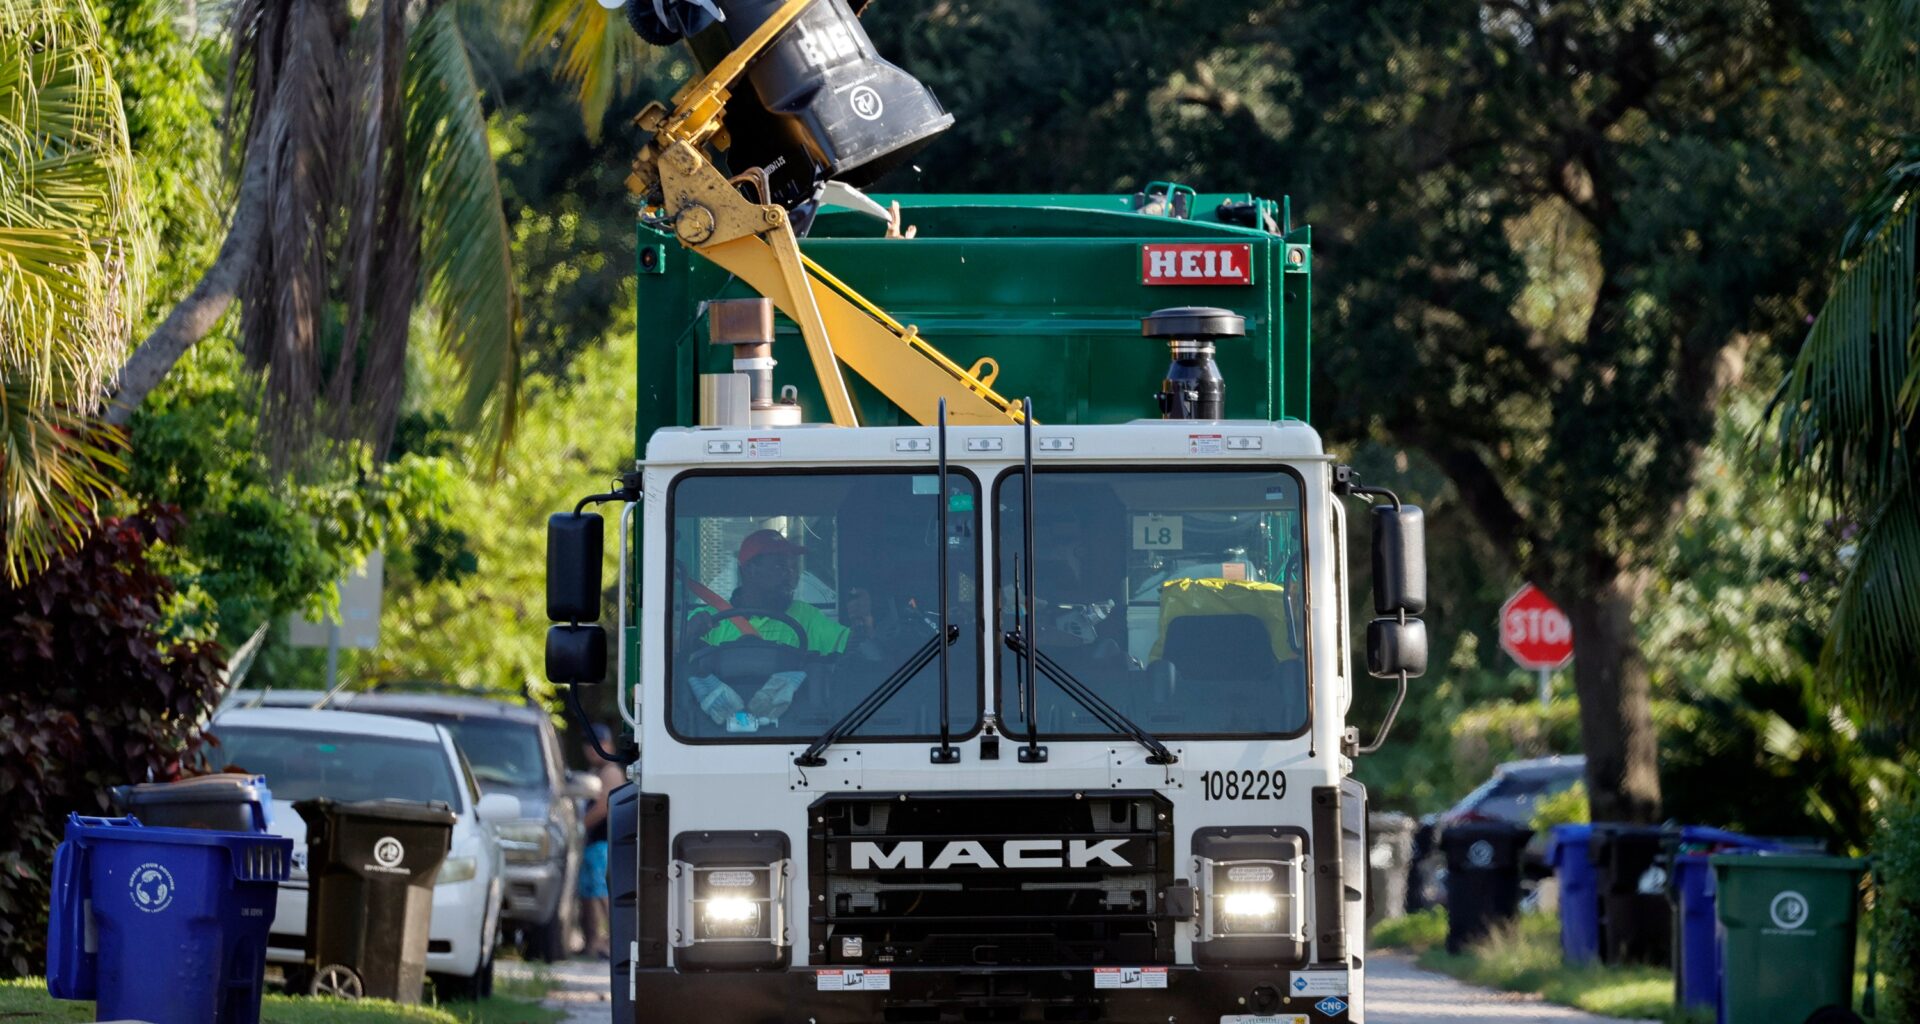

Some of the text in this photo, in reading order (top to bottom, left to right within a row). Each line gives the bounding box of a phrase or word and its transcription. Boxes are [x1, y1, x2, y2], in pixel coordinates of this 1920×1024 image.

[1150, 250, 1243, 277] HEIL
[1144, 526, 1172, 545] L8
[1200, 769, 1287, 801] 108229
[850, 839, 1133, 869] MACK
[1321, 1001, 1342, 1011] CNG
